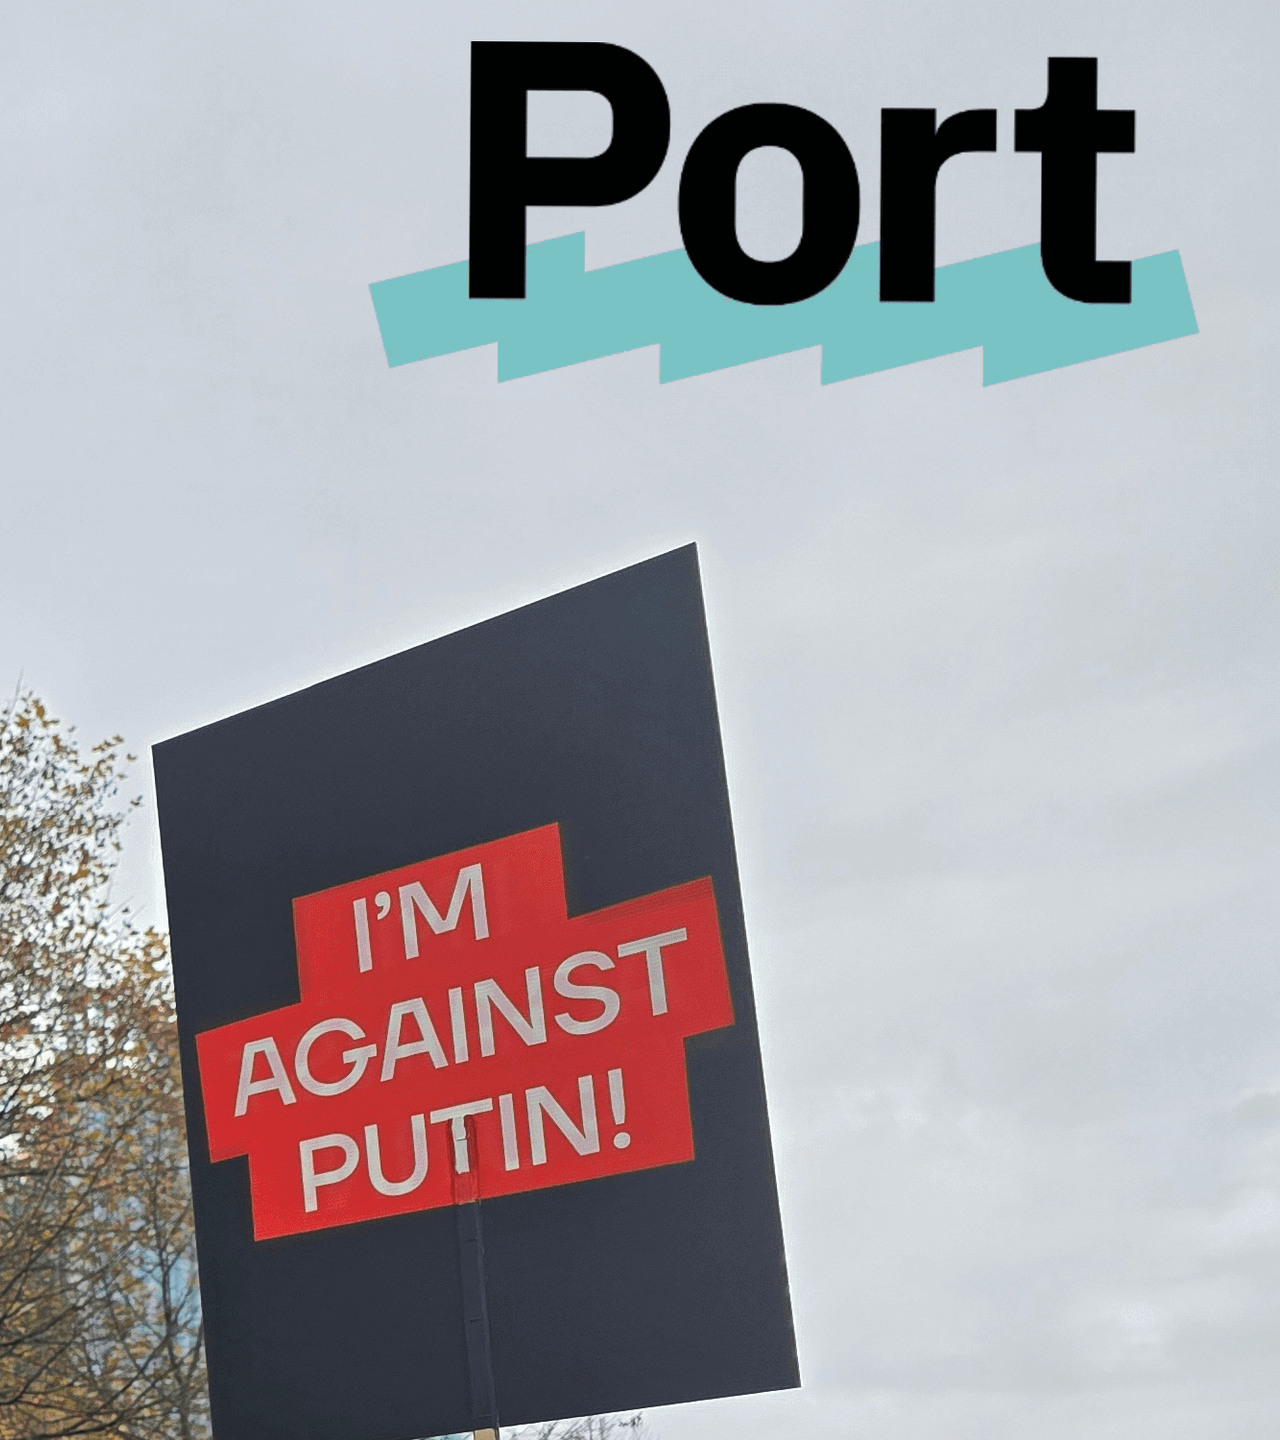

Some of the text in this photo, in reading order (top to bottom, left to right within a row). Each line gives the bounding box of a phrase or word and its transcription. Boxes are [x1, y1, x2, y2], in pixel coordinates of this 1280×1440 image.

[352, 862, 490, 973] I'M
[233, 927, 688, 1118] AGAINST
[298, 1067, 632, 1213] PUTIN!
